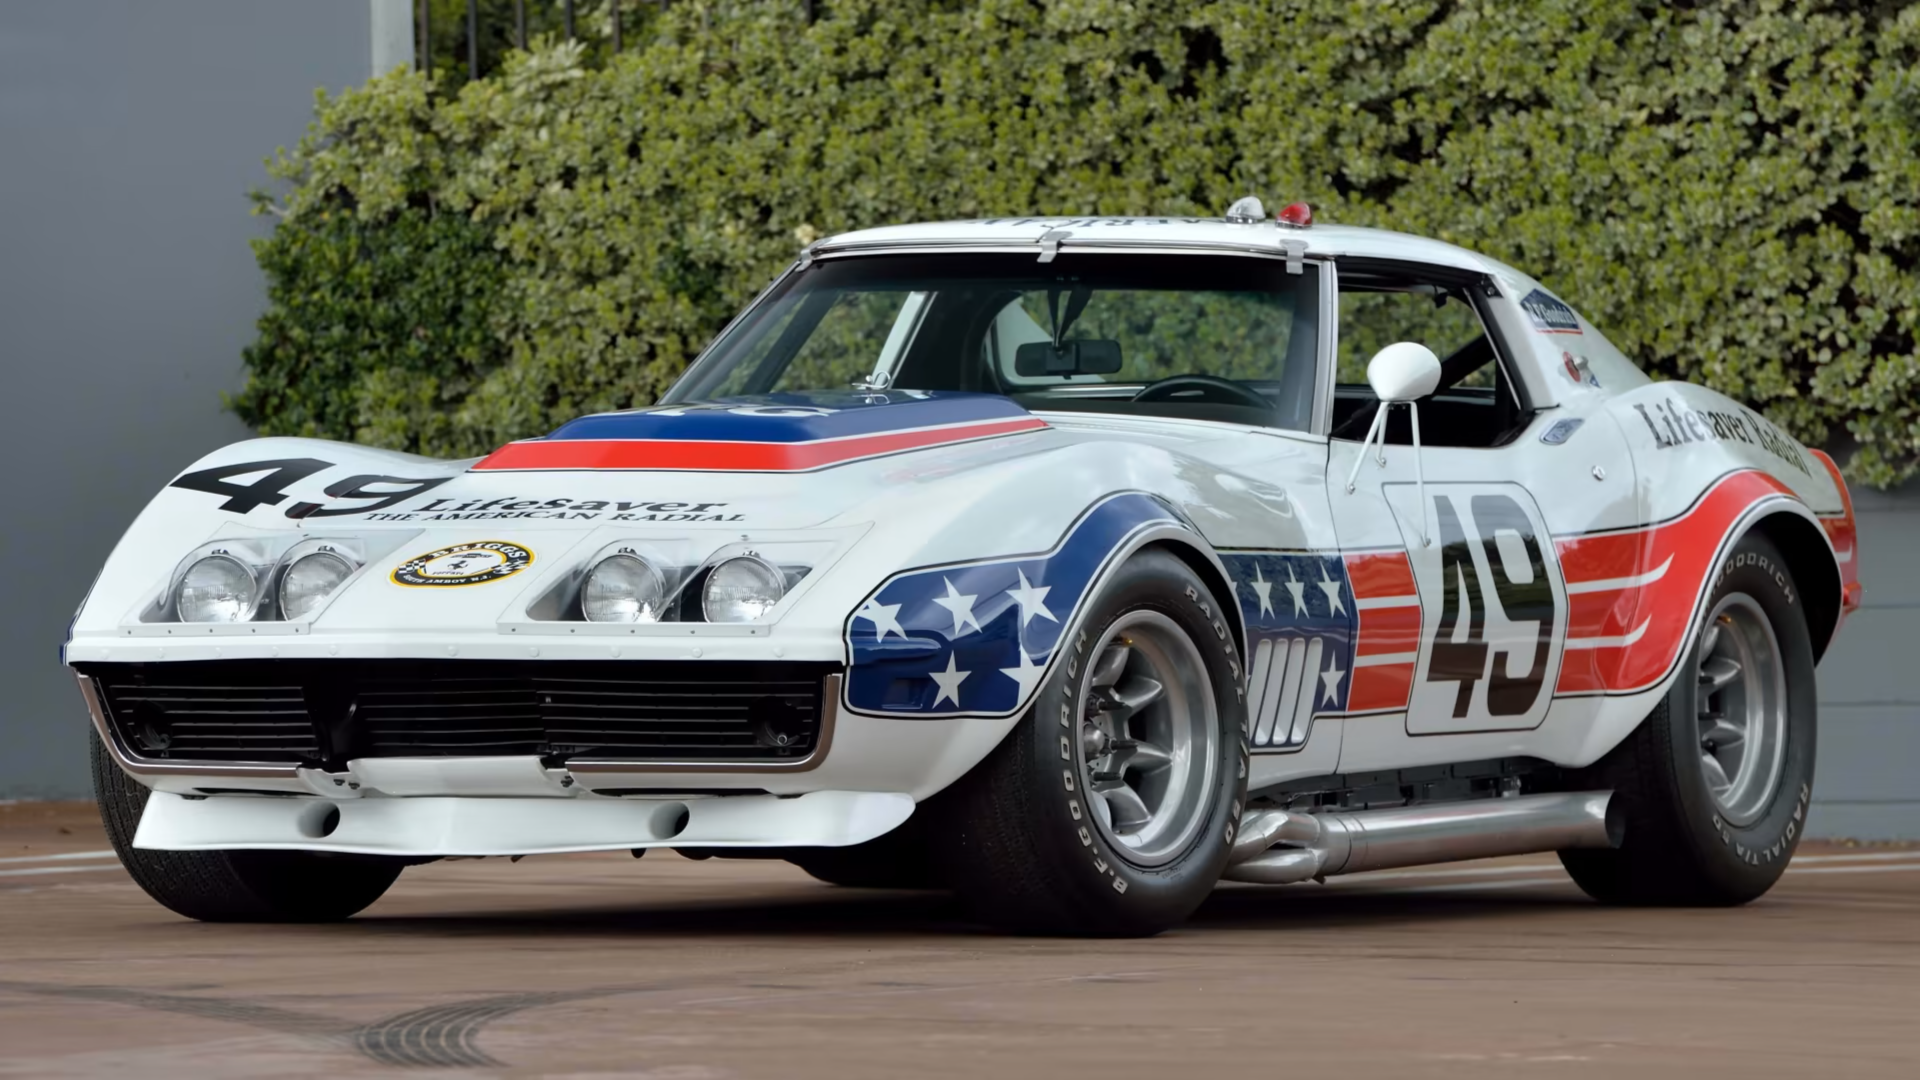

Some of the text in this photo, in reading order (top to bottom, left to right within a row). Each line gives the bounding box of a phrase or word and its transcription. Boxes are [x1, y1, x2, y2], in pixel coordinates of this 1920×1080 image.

[1633, 397, 1813, 480] Lifesaver Radial
[168, 457, 455, 520] 49
[363, 511, 746, 522] THE AMERICAN RADIAL
[412, 496, 729, 513] Lifesaver
[428, 542, 528, 558] BRIGGS
[1426, 494, 1556, 719] 49
[1185, 584, 1243, 706] RADIAL
[1762, 782, 1809, 863] RADIAL
